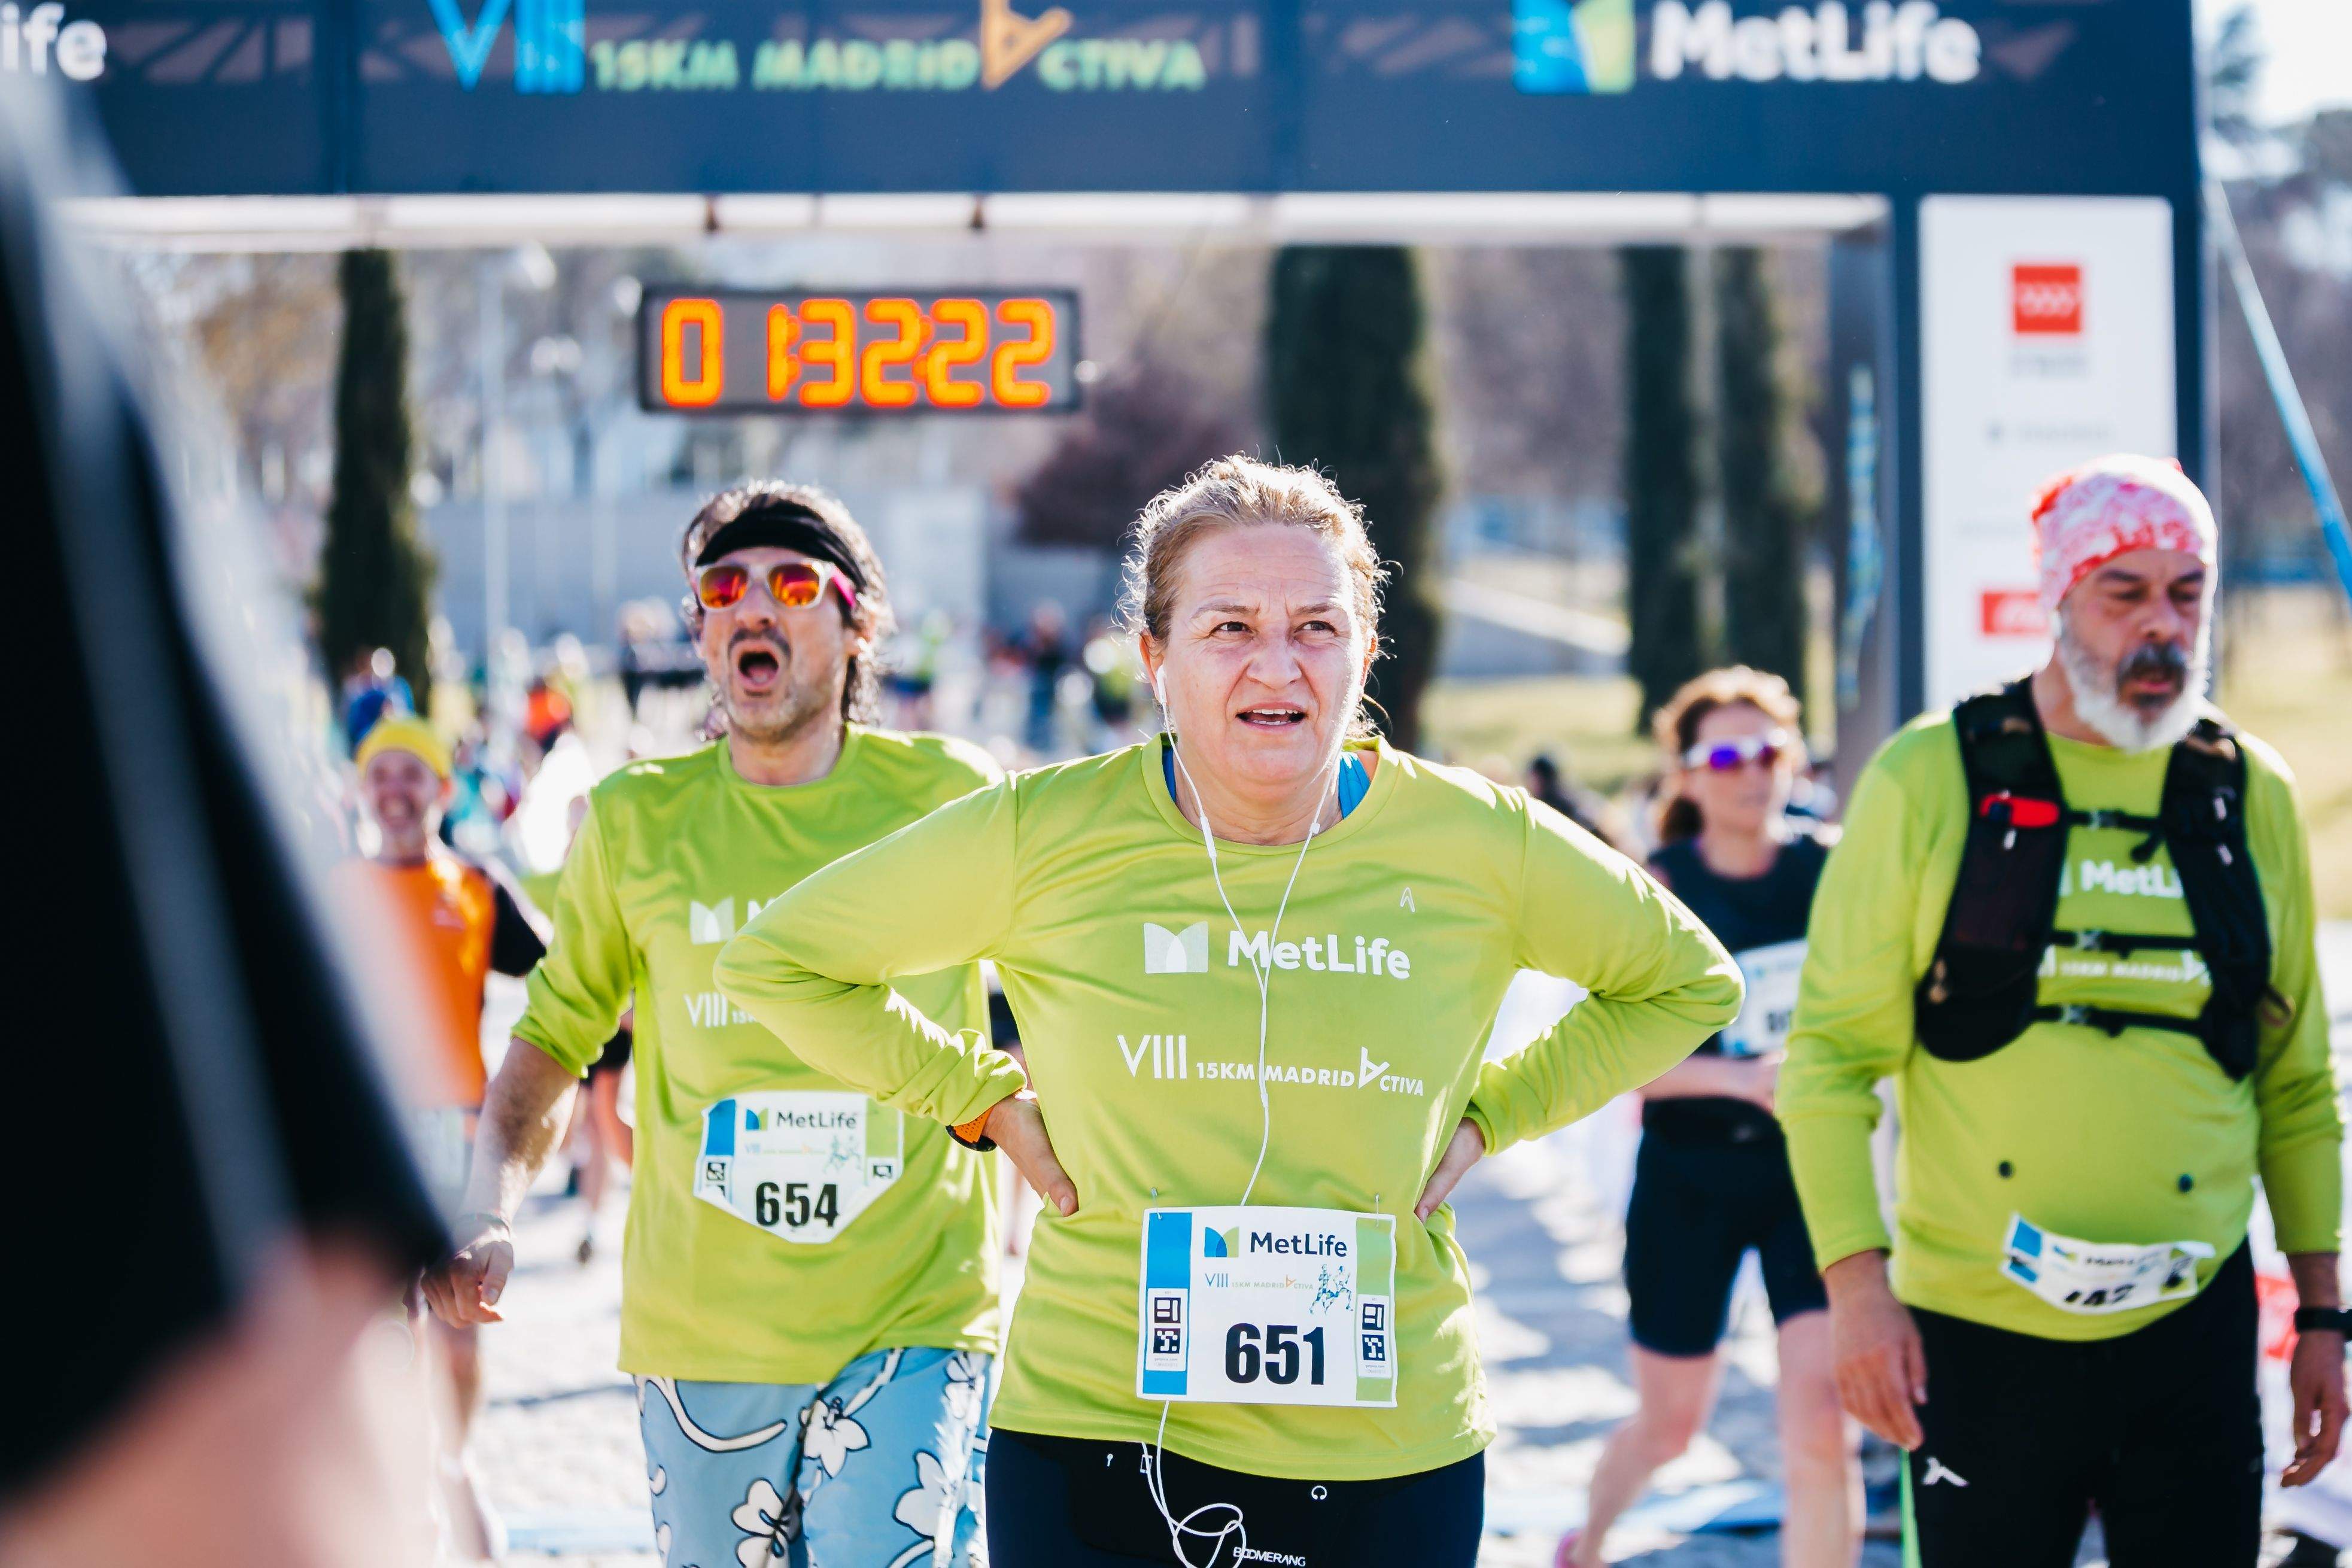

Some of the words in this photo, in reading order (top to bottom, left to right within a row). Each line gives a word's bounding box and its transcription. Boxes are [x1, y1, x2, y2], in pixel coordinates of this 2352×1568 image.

[1649, 0, 1982, 83] MetLife
[1228, 930, 1411, 979] MetLife
[1117, 1035, 1187, 1079] VIII
[1196, 1062, 1256, 1081] 15KM
[1265, 1065, 1355, 1088] MADRID
[777, 1111, 857, 1129] MetLife
[755, 1182, 839, 1228] 654
[1250, 1232, 1348, 1257] MetLife
[1205, 1273, 1229, 1288] VIII
[1224, 1322, 1325, 1385] 651
[1233, 1546, 1306, 1567] BOOMERANG
